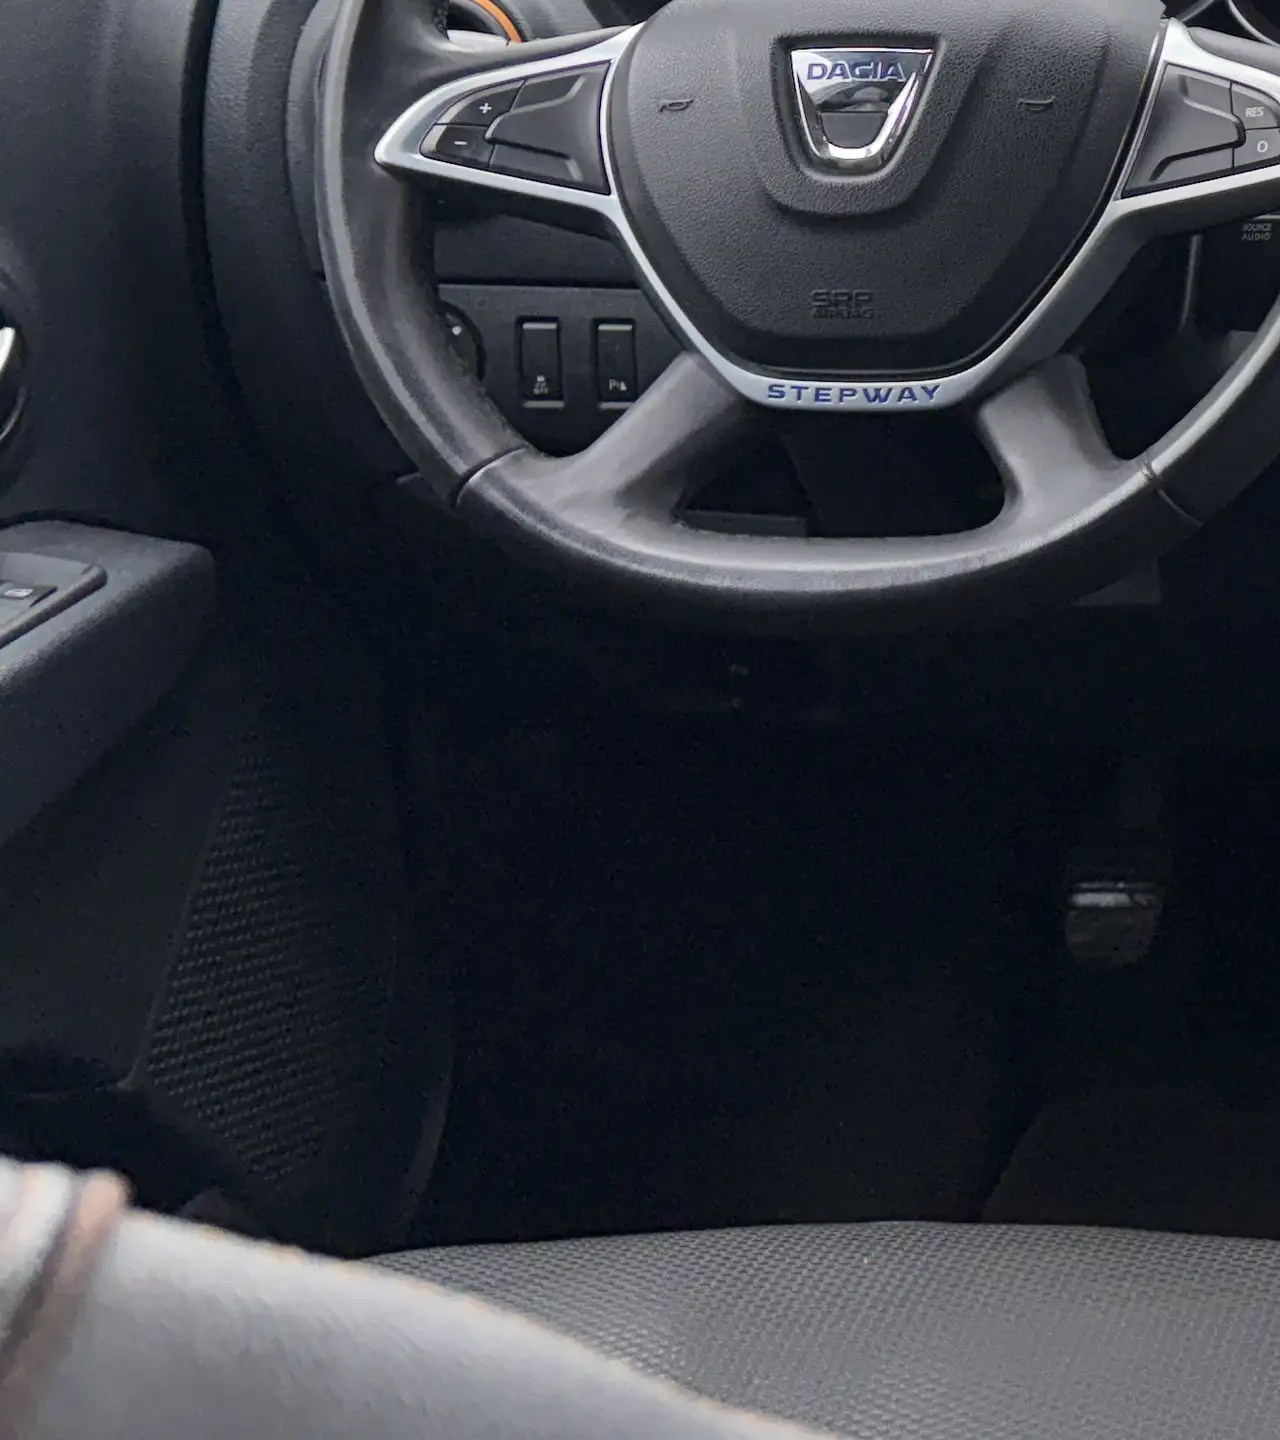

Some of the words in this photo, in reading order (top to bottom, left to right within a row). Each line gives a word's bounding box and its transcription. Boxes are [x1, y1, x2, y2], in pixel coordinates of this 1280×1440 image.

[806, 61, 906, 81] DACIA
[1245, 106, 1265, 118] RES
[767, 383, 941, 404] STEPWAY
